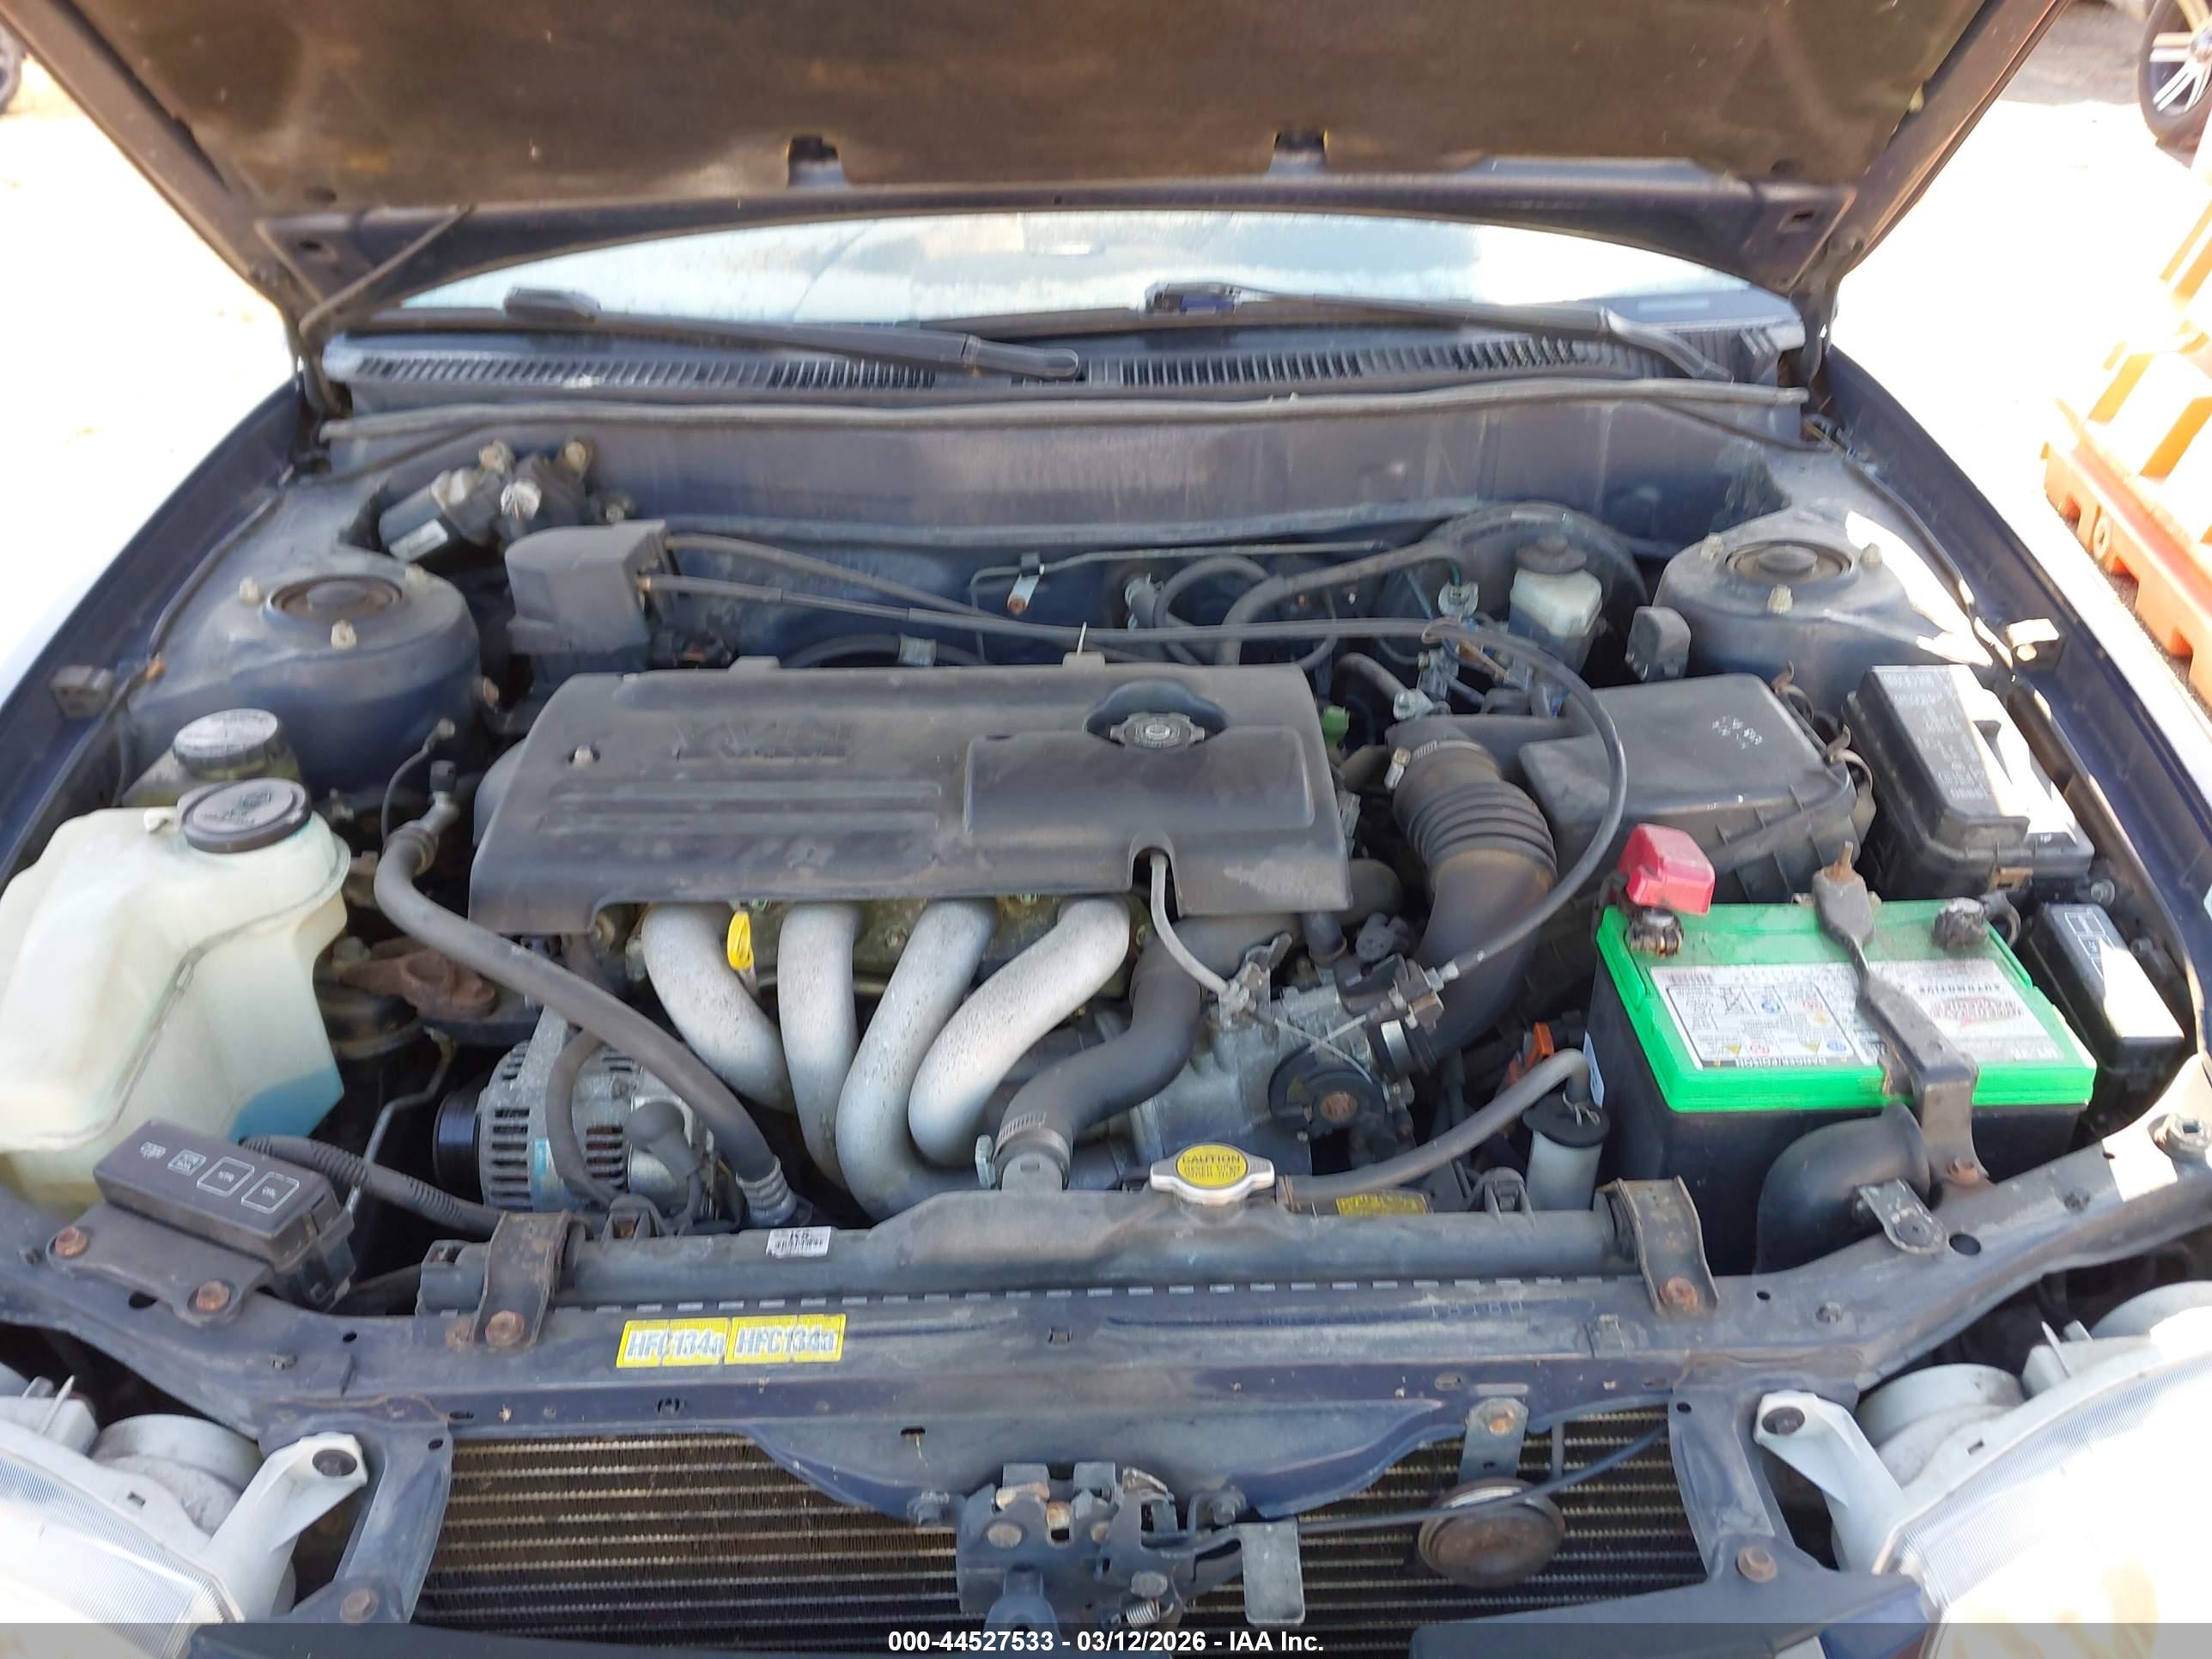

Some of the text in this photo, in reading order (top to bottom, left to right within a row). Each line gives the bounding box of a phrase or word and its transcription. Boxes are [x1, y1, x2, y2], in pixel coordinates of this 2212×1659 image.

[1182, 1154, 1241, 1164] CAUTION
[627, 1327, 835, 1358] HFC134a HFC134a
